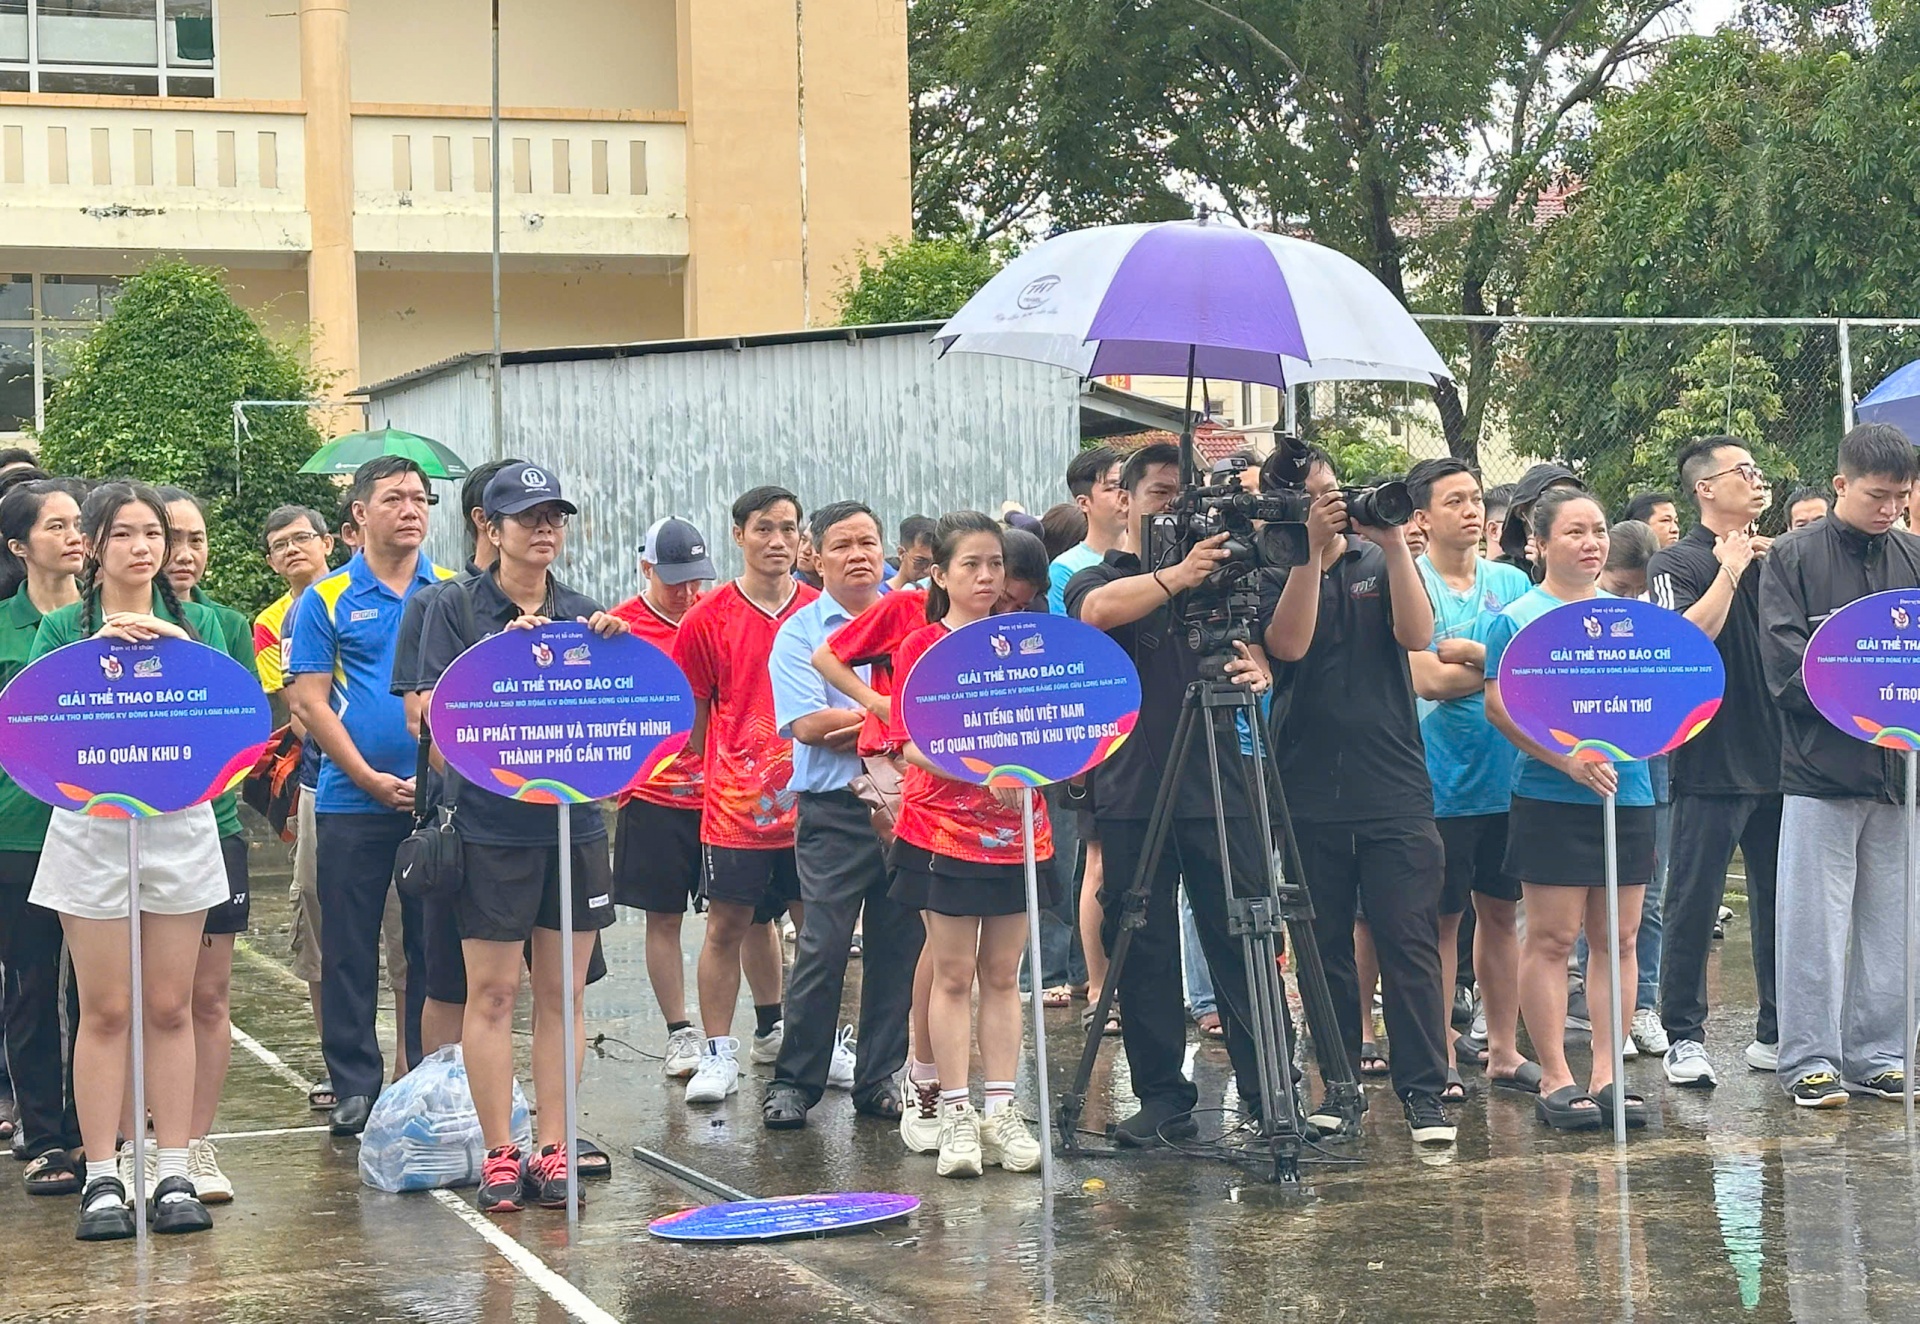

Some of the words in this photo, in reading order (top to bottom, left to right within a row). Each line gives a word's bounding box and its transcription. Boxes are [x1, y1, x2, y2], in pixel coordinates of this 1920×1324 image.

[1856, 636, 1879, 650] GIẢI
[1881, 635, 1902, 650] THỂ
[1550, 647, 1572, 661] GIẢI
[1574, 645, 1594, 661] THỂ
[1596, 649, 1626, 661] THAO
[1628, 647, 1652, 660] BÁO
[1653, 647, 1671, 660] CHÍ
[957, 669, 981, 685] GIẢI
[983, 664, 1005, 683] THỂ
[1006, 667, 1039, 681] THAO
[1040, 664, 1065, 678] BÁO
[1066, 660, 1085, 675] CHÍ
[492, 677, 519, 693] GIẢI
[521, 674, 545, 692] THỂ
[547, 678, 583, 691] THAO
[584, 676, 612, 690] BÁO
[613, 675, 634, 689] CHÍ
[58, 690, 86, 707] GIẢI
[88, 687, 114, 706] THỂ
[116, 690, 154, 704] THAO
[156, 688, 185, 703] BÁO
[186, 687, 208, 702] CHÍ
[665, 694, 681, 702] 2025
[1572, 700, 1602, 714] VNPT
[1604, 694, 1628, 713] CẦN
[1630, 698, 1652, 713] THƠ
[240, 706, 257, 715] 2025
[963, 710, 982, 728] ĐÀI
[982, 706, 1015, 726] TIẾNG
[1015, 705, 1035, 723] NÓI
[1035, 703, 1058, 723] VIỆT
[1060, 703, 1085, 719] NAM
[456, 724, 480, 743] ĐÀI
[482, 723, 517, 742] PHÁT
[519, 724, 564, 741] THANH
[566, 720, 584, 739] VÀ
[586, 717, 637, 739] TRUYỀN
[639, 718, 672, 737] HÌNH
[930, 738, 945, 755] CƠ
[946, 736, 976, 754] QUAN
[976, 730, 1019, 750] THƯỜNG
[1019, 727, 1042, 746] TRÚ
[1042, 727, 1064, 744] KHU
[1064, 724, 1086, 744] VỰC
[1087, 721, 1121, 739] ĐBSCL
[77, 746, 106, 765] BÁO
[109, 743, 149, 764] QUÂN
[151, 745, 180, 762] KHU
[182, 745, 192, 760] 9
[499, 746, 544, 766] THÀNH
[546, 742, 573, 764] PHỐ
[576, 742, 604, 763] CẦN
[605, 744, 632, 762] THƠ
